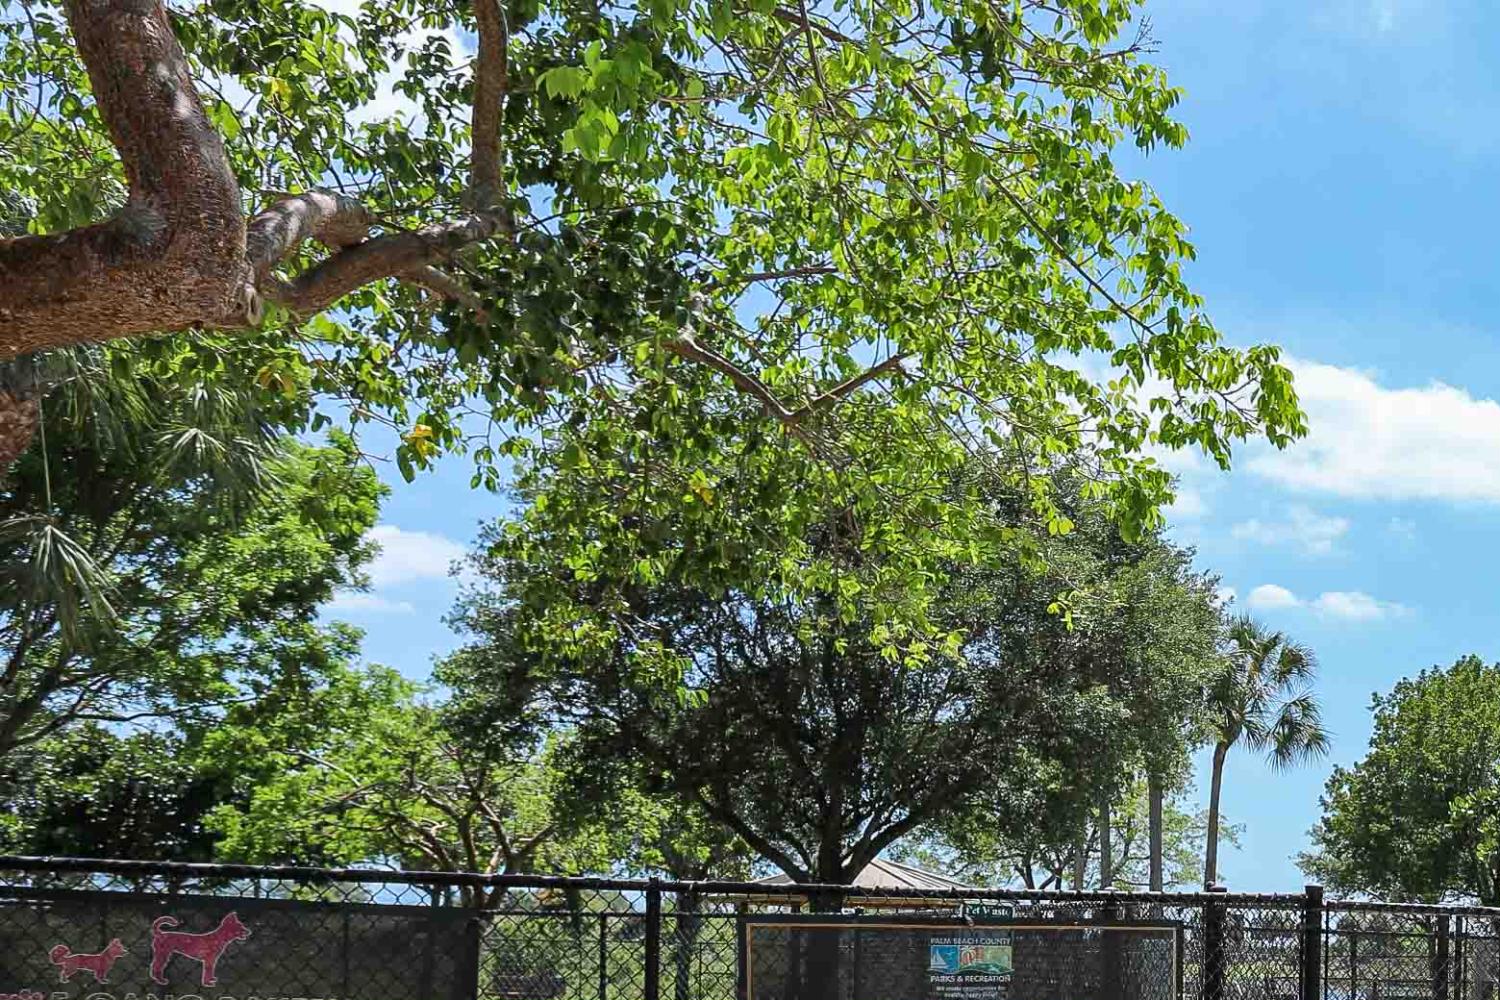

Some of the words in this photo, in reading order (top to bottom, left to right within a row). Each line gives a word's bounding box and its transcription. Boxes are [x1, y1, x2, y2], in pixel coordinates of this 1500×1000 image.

[980, 937, 1011, 945] COUNTY
[930, 975, 955, 983] PARKS
[956, 975, 964, 983] &
[964, 975, 1011, 983] RECREATION
